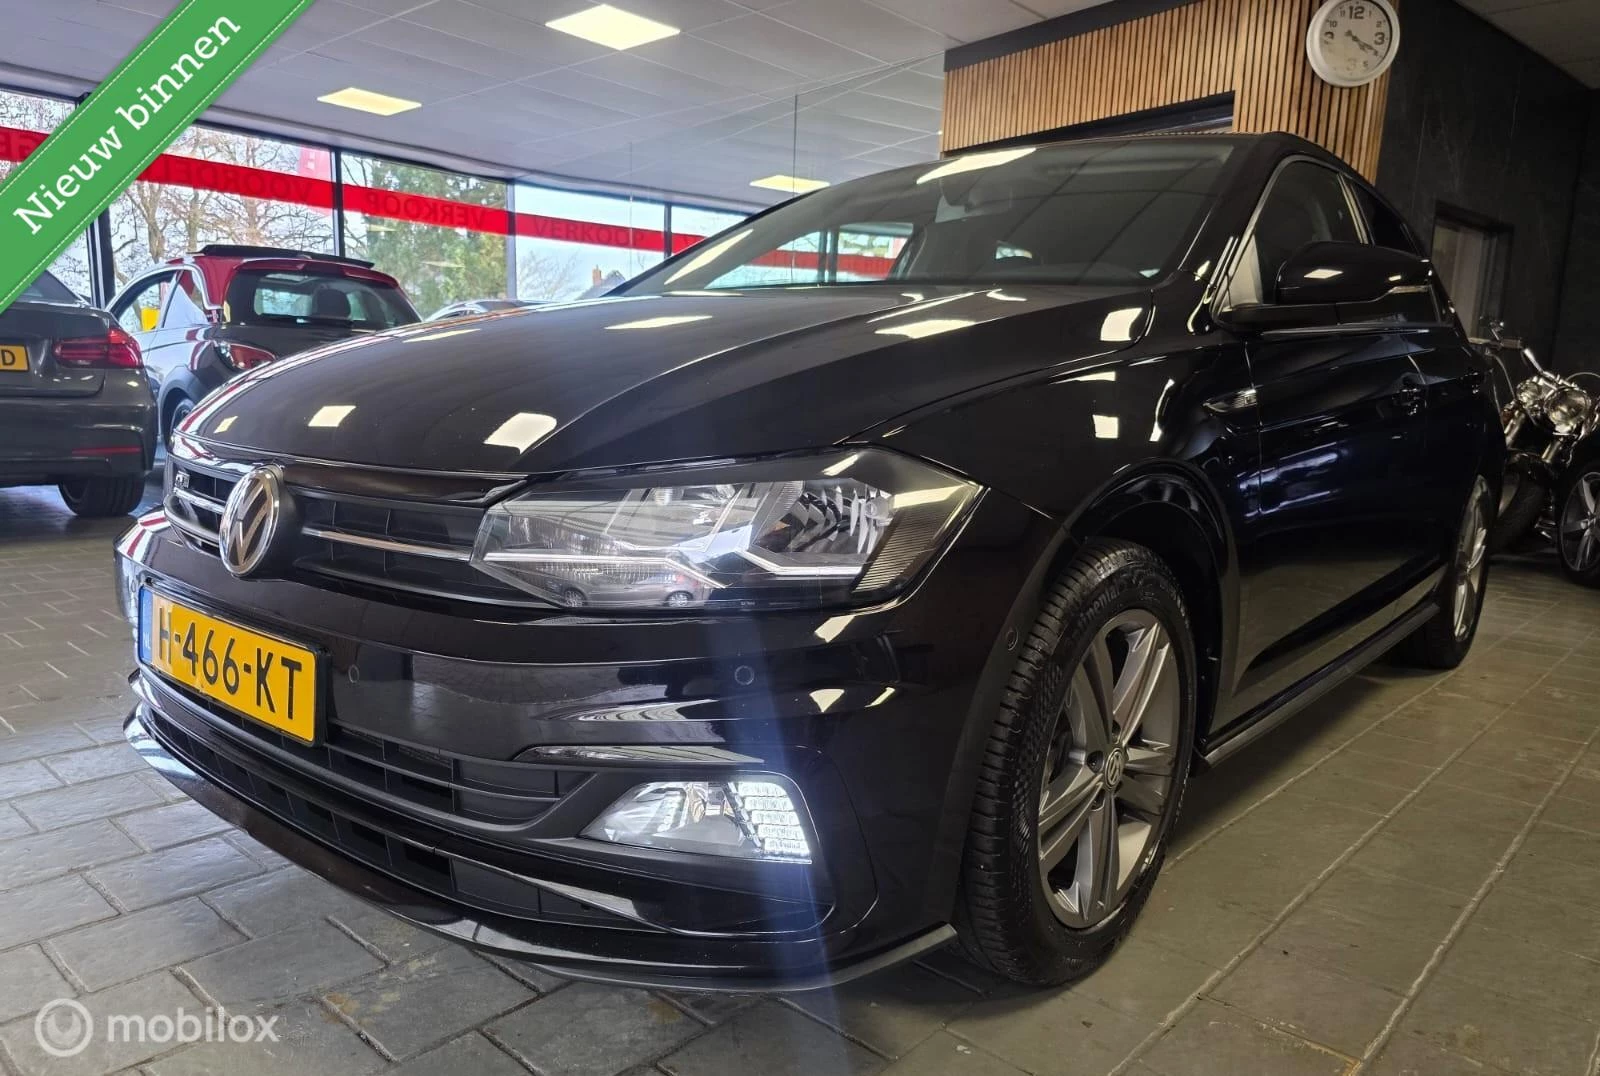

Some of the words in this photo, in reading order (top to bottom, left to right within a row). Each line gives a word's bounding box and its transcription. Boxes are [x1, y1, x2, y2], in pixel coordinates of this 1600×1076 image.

[1348, 5, 1365, 20] 12
[1374, 31, 1385, 45] 3
[534, 217, 645, 247] VERKOOP
[158, 607, 302, 720] H-466-KT
